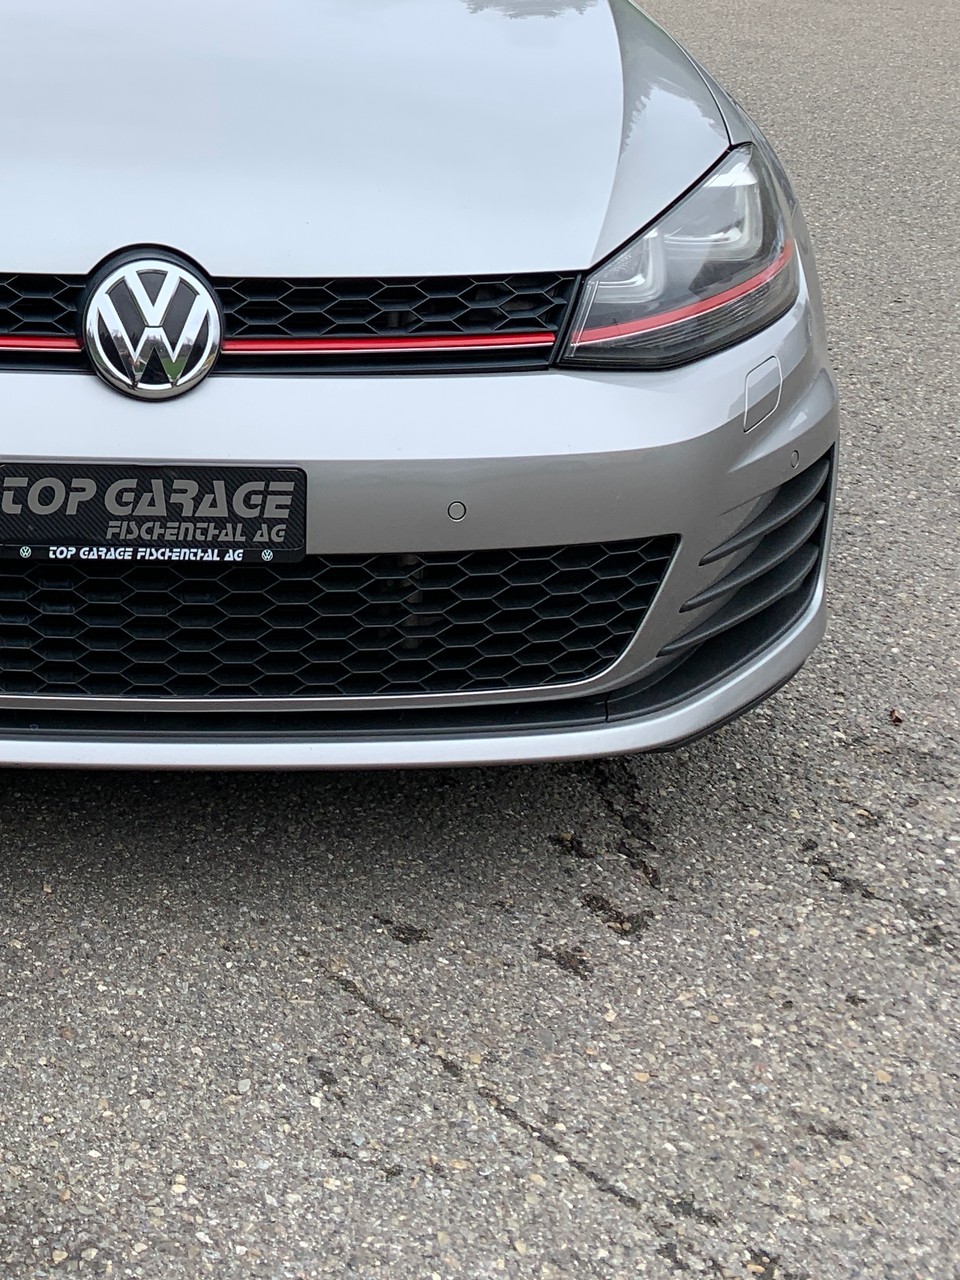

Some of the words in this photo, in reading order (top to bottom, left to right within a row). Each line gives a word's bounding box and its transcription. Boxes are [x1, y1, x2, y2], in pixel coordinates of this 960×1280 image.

[1, 477, 97, 516] TOP
[104, 479, 295, 519] GARAGE
[105, 520, 246, 542] FISCHENTHAL
[253, 523, 287, 542] AG
[48, 546, 77, 559] TOP
[79, 546, 133, 560] GARAGE
[136, 548, 221, 561] FISCHENTHAL
[223, 549, 244, 561] AG
